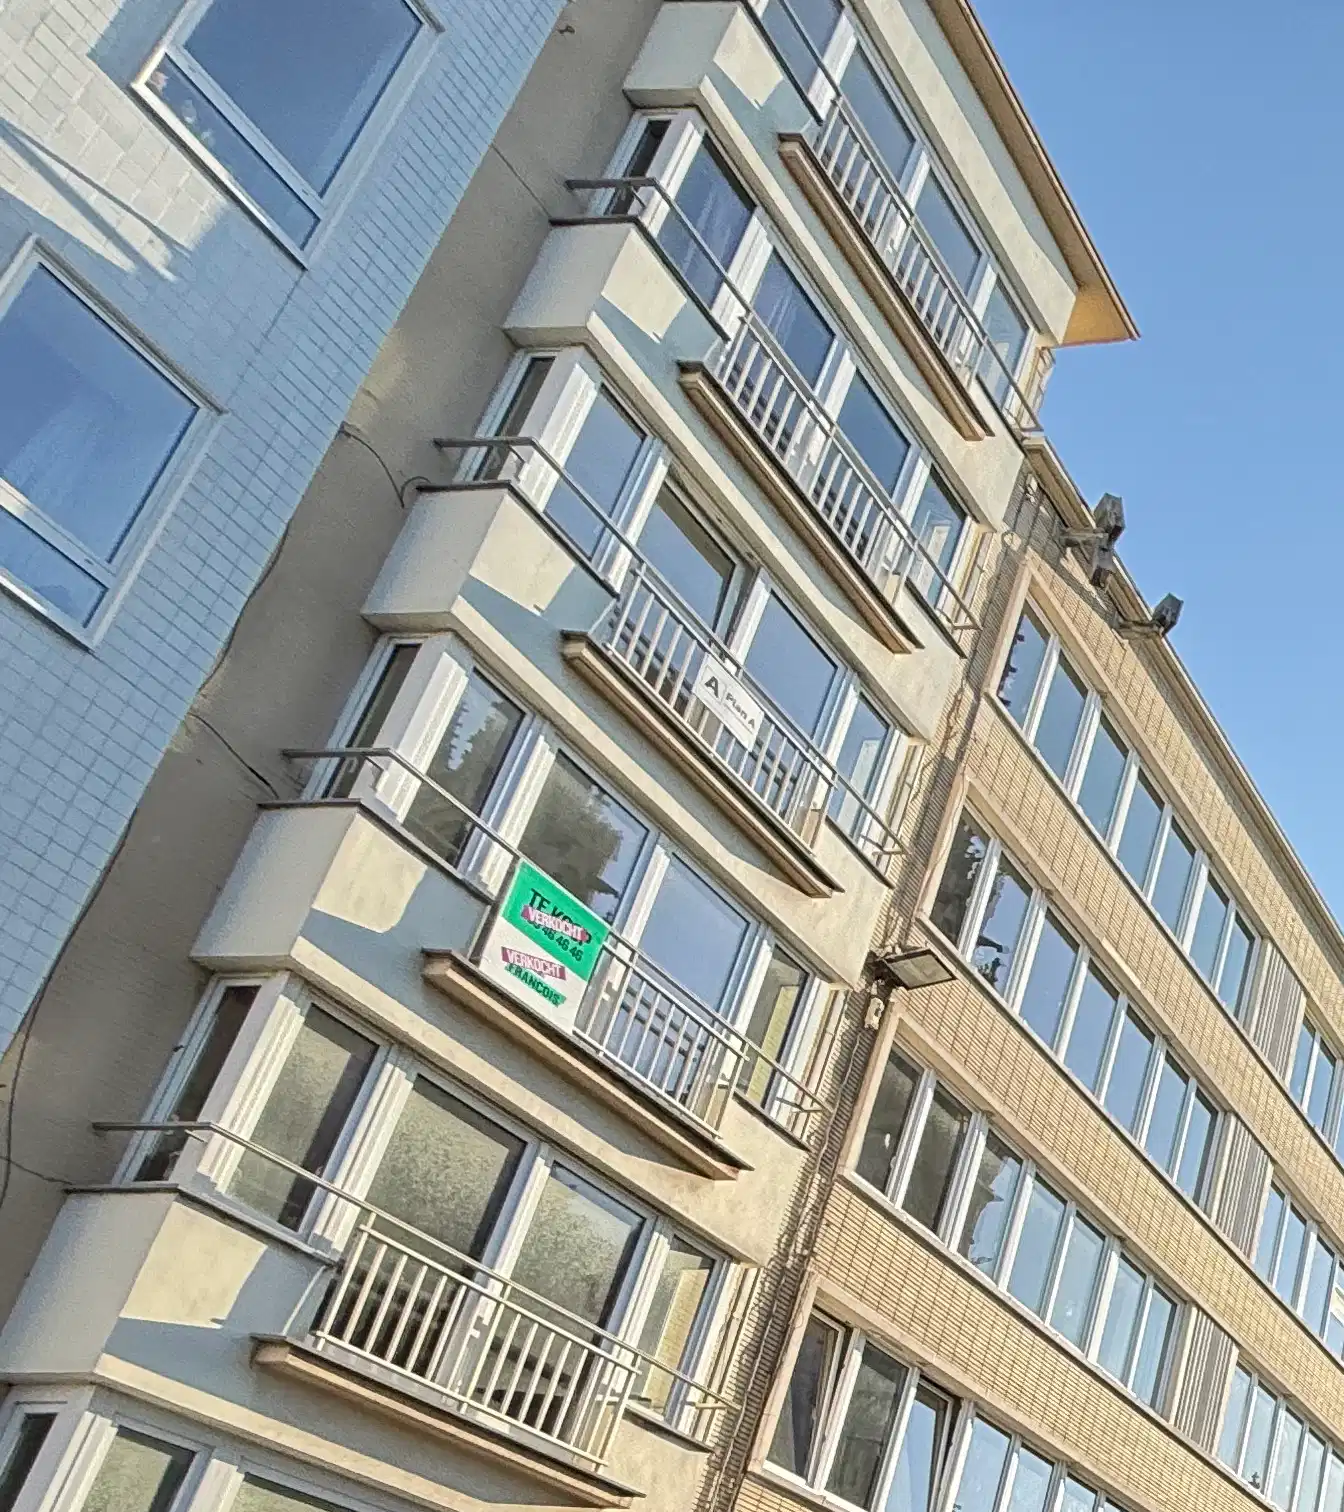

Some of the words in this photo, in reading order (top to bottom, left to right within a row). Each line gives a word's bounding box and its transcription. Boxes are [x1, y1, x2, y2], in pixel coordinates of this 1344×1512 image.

[704, 675, 719, 699] A
[527, 907, 585, 941] VERKOCHT
[506, 949, 563, 978] VERKOCHT
